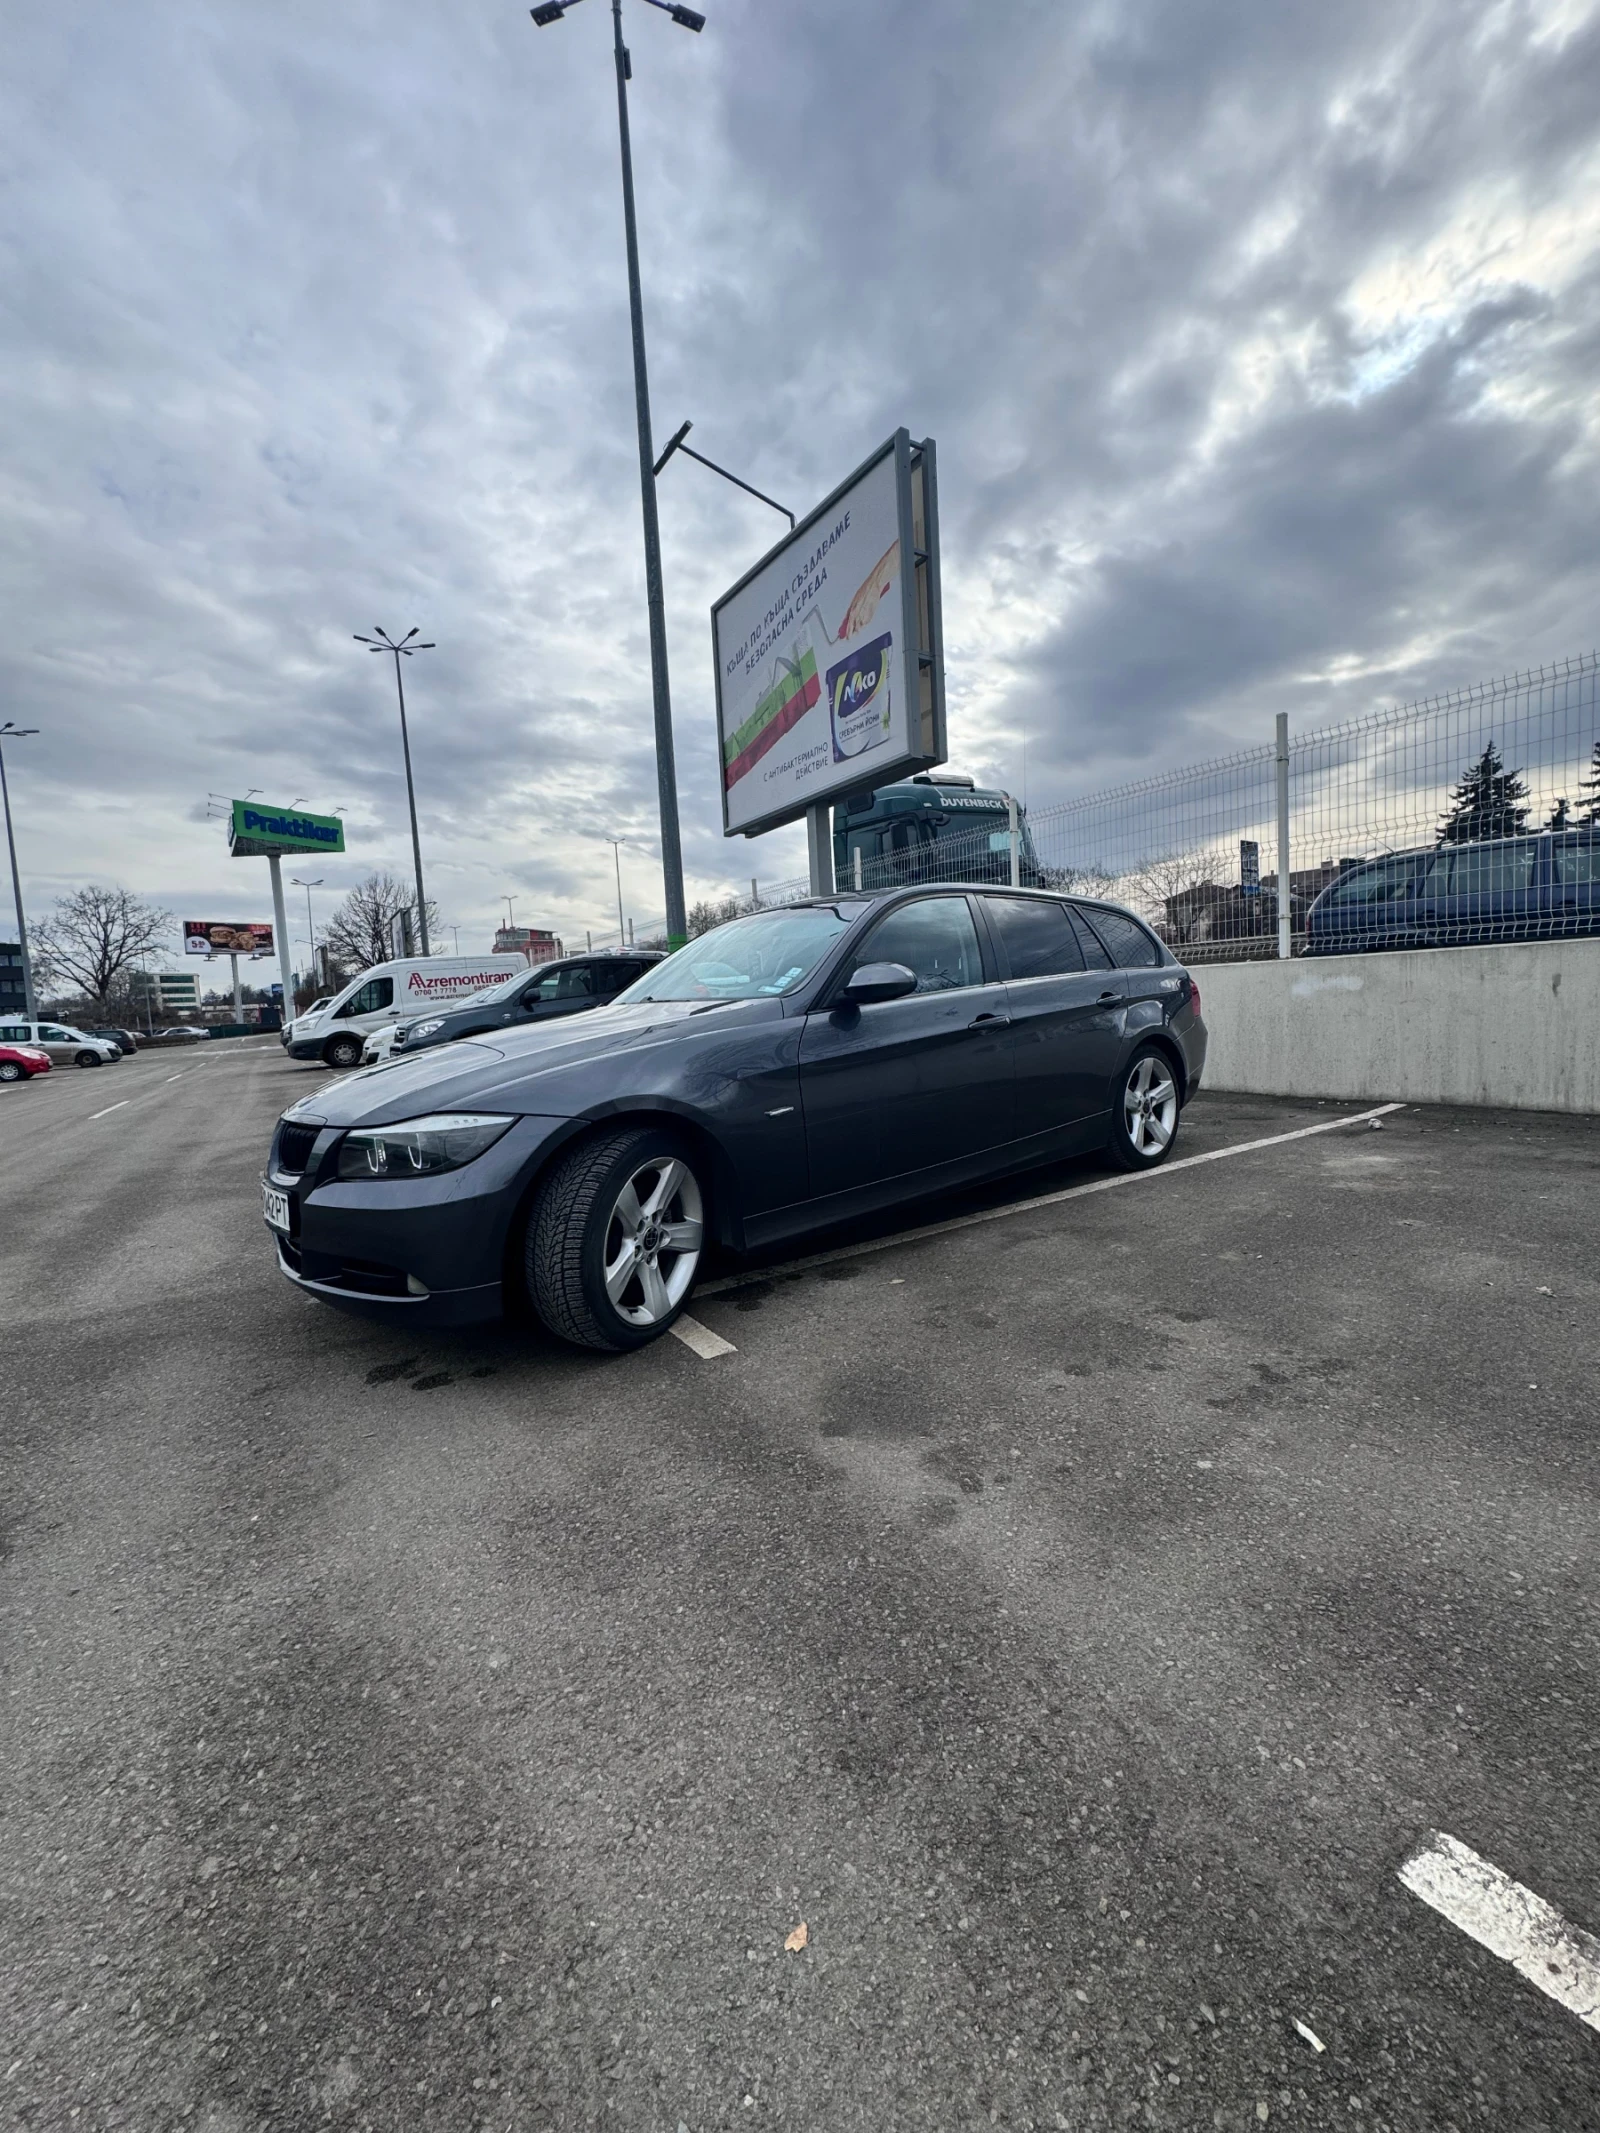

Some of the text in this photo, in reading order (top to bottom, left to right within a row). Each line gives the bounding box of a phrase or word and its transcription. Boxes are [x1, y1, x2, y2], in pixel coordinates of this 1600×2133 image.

[726, 510, 851, 677] КЪЩА ПО КЪЩА СЪЗДАВАМЕ
[745, 567, 828, 675] БЕЗОПАСНА СРЕДА
[839, 720, 865, 740] СРЕБЪРНИ
[763, 741, 829, 782] С АНТИБАКТЕРИАЛНО
[795, 756, 829, 781] ДЕЙСТВИЕ
[940, 797, 1004, 809] DUVENBECK
[243, 809, 340, 844] Praktiker
[408, 972, 514, 990] Azremontiram
[414, 989, 432, 997] 0700
